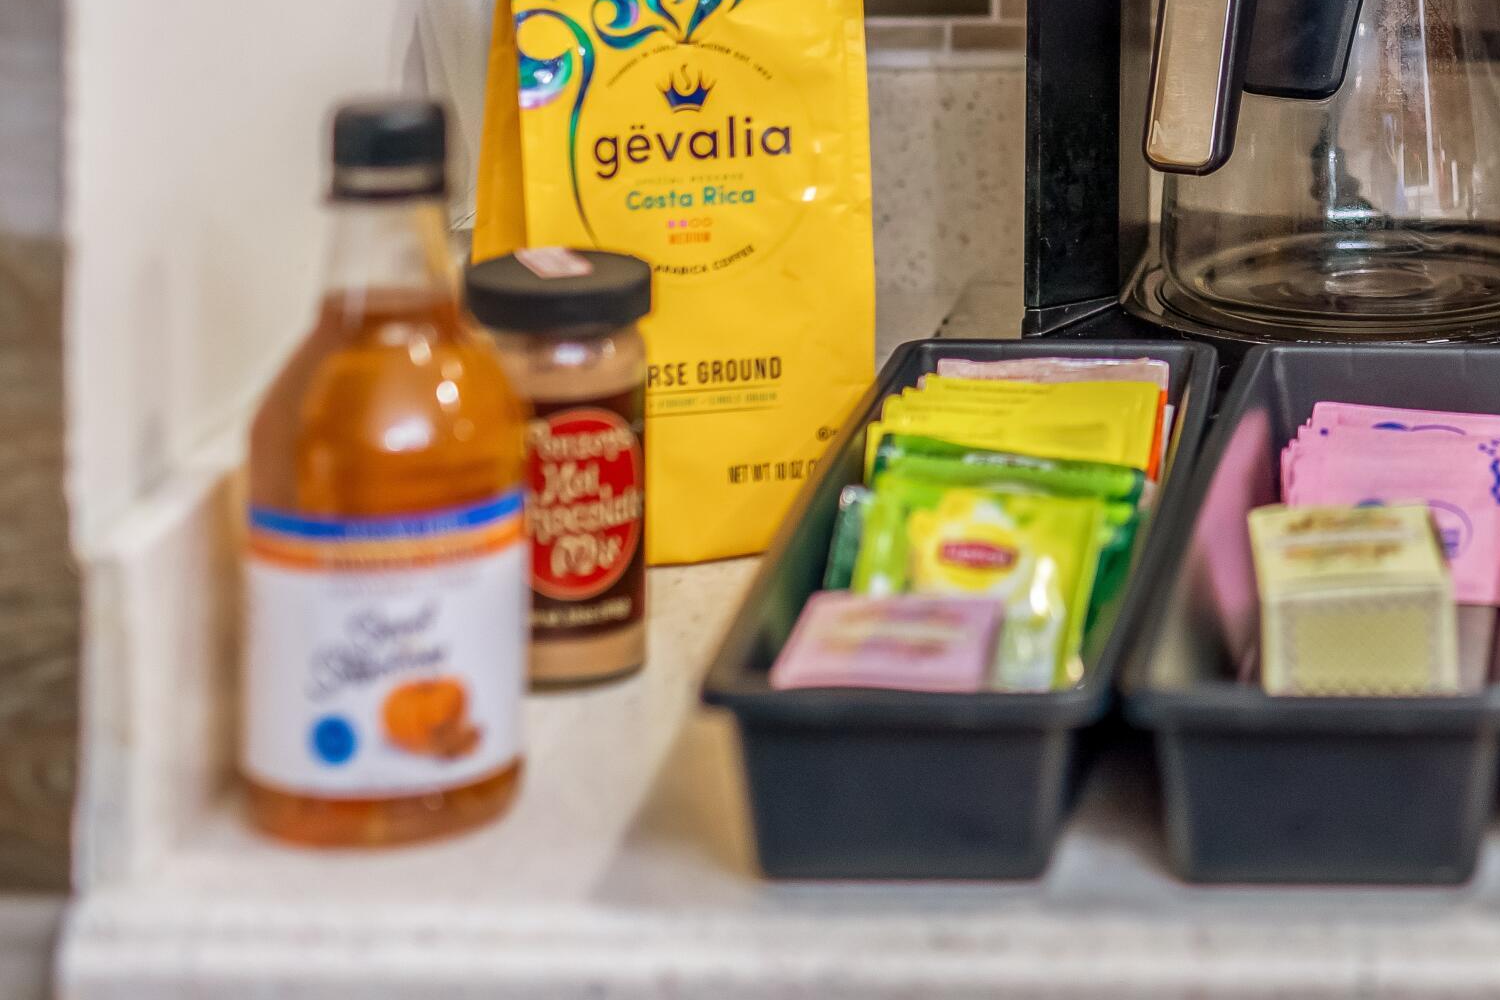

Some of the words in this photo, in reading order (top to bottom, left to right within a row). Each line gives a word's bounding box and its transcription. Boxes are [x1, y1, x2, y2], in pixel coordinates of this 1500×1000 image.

[594, 115, 791, 180] gëvalia
[626, 190, 693, 210] Costa
[703, 185, 755, 205] Rica
[697, 356, 782, 384] GROUND
